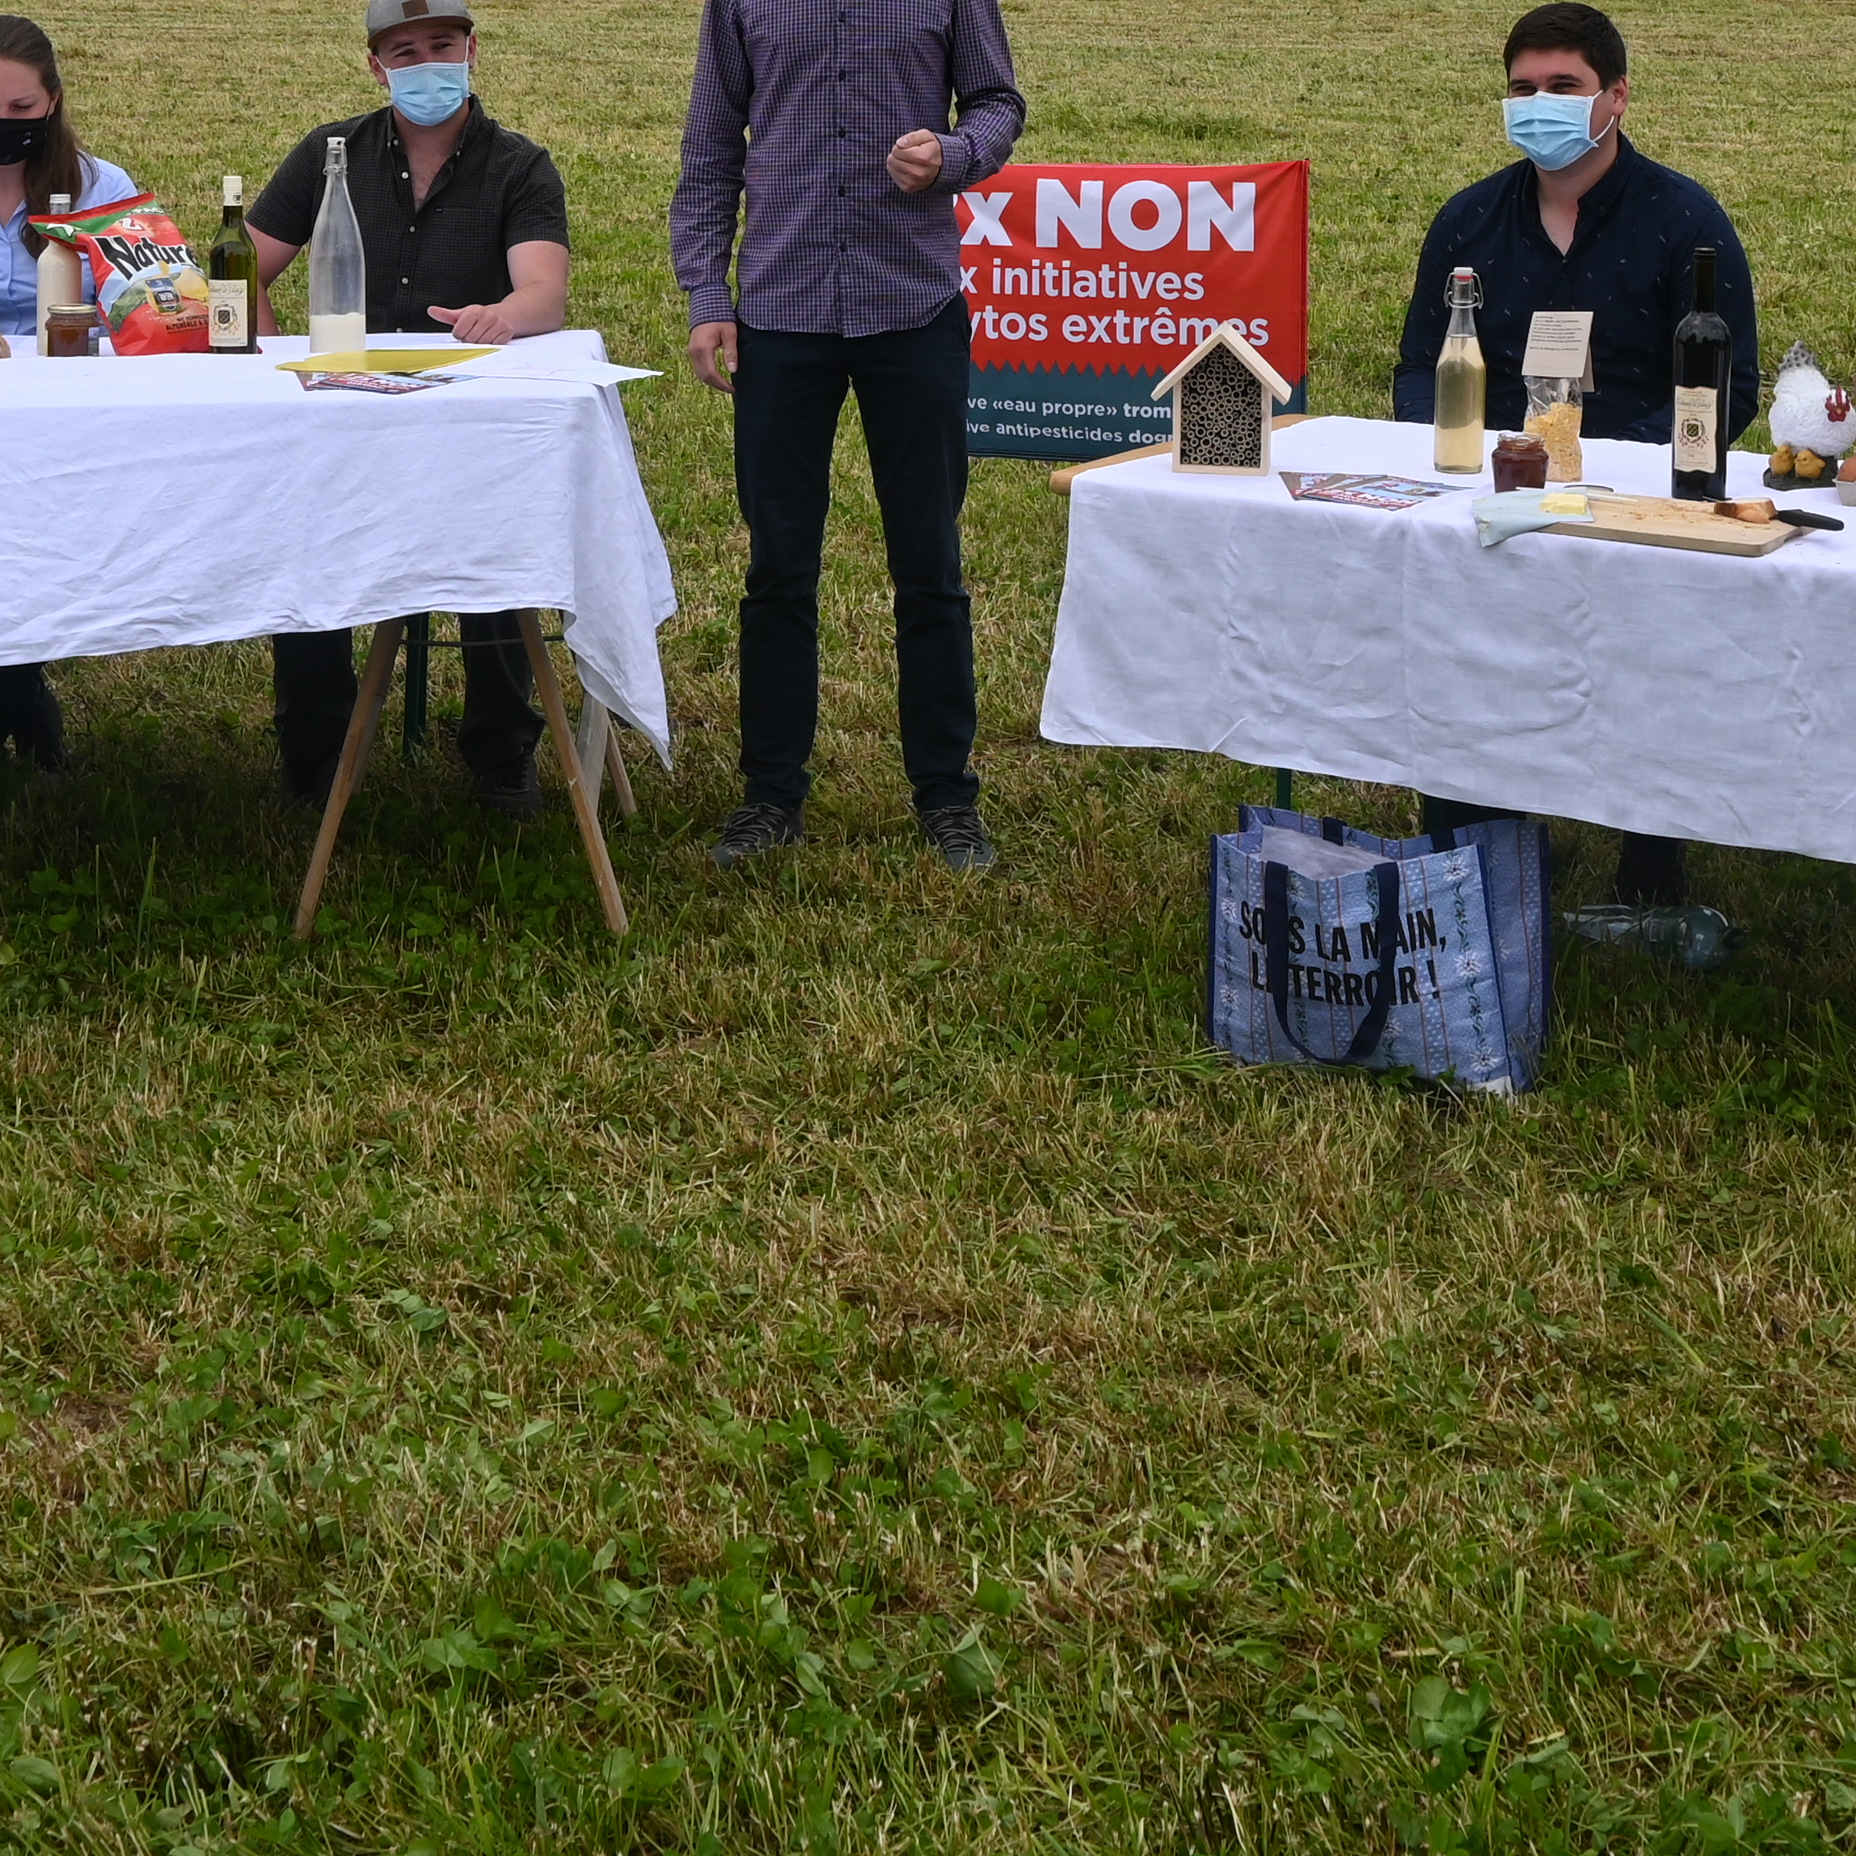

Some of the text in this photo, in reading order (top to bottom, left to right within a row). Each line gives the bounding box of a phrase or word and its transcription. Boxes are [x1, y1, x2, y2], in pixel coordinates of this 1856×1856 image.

[953, 177, 1256, 252] x NON
[94, 235, 202, 281] Nature
[992, 257, 1205, 301] initiatives
[1062, 306, 1269, 346] extrêmes
[993, 399, 1036, 413] «eau
[1042, 401, 1118, 418] propre»
[1123, 402, 1172, 419] trom
[996, 422, 1123, 443] antipesticides
[1239, 900, 1307, 955] SOS
[1314, 923, 1352, 963] LA
